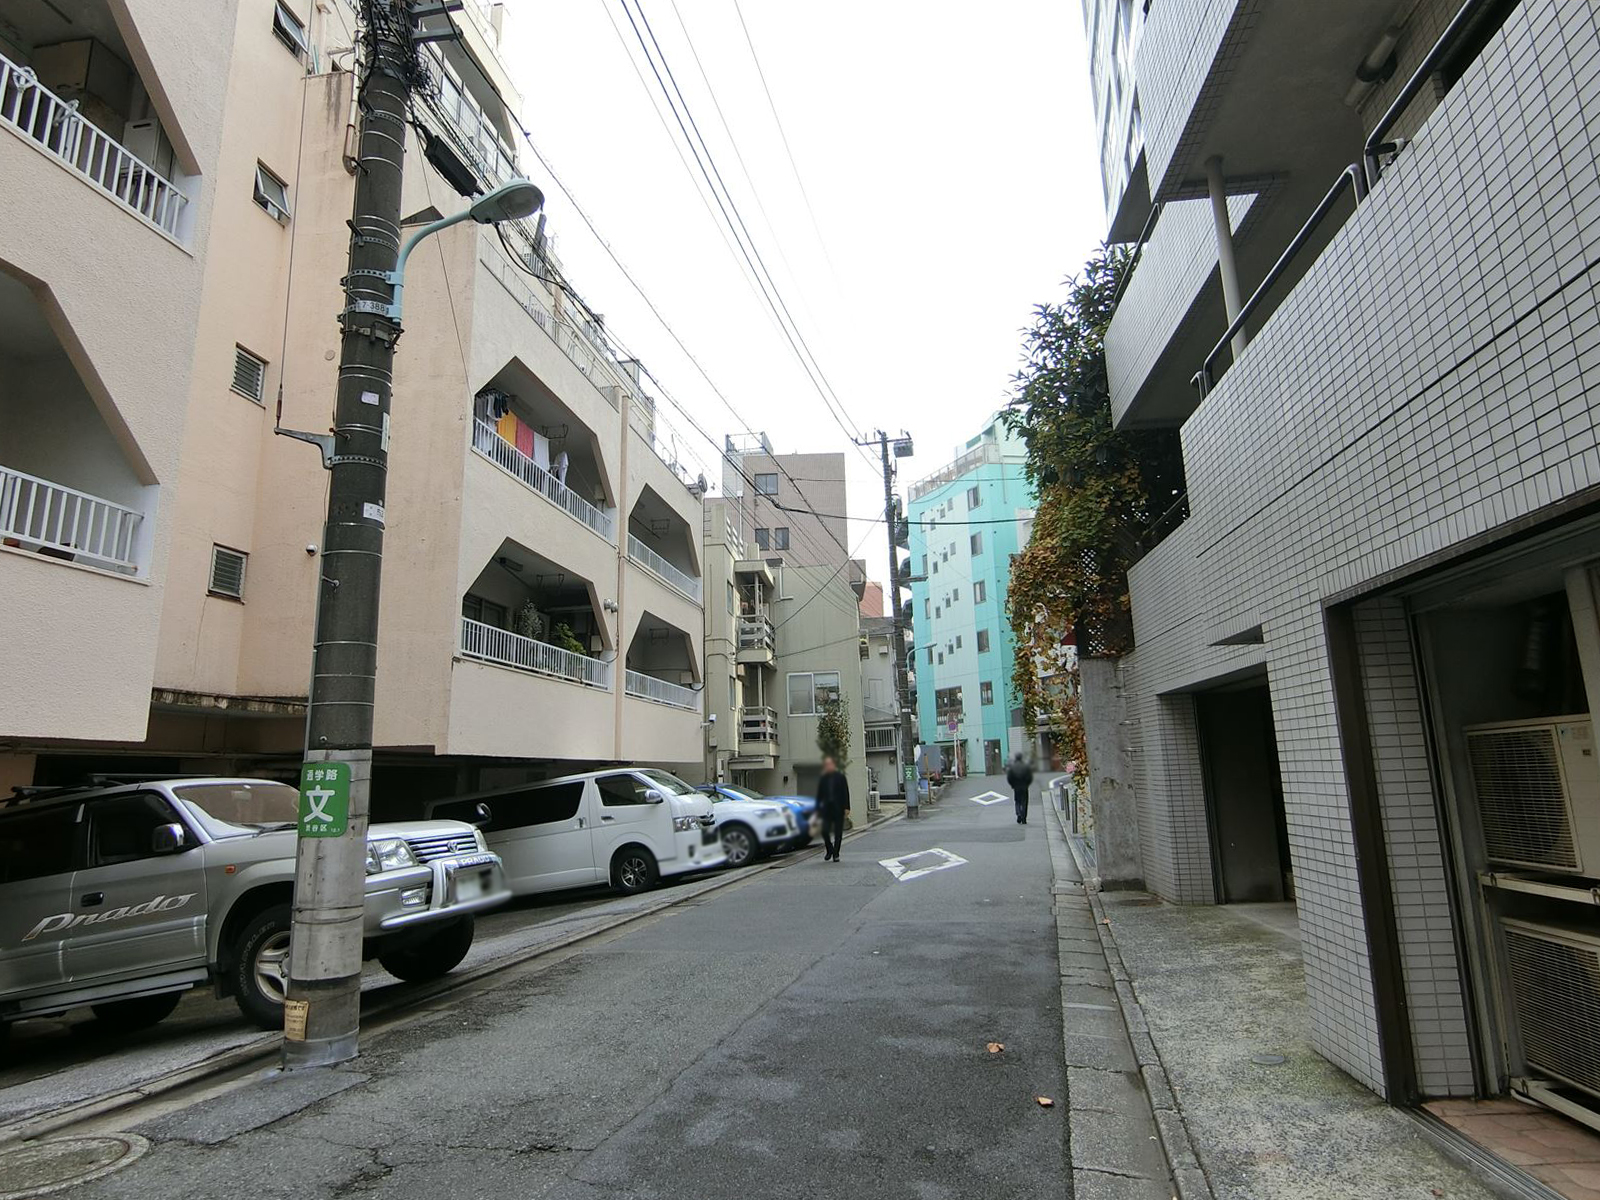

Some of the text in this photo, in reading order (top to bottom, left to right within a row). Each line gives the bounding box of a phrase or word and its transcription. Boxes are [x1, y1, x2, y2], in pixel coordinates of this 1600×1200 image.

[306, 769, 338, 781] 通学路
[303, 784, 336, 823] 文
[21, 892, 198, 942] Prado
